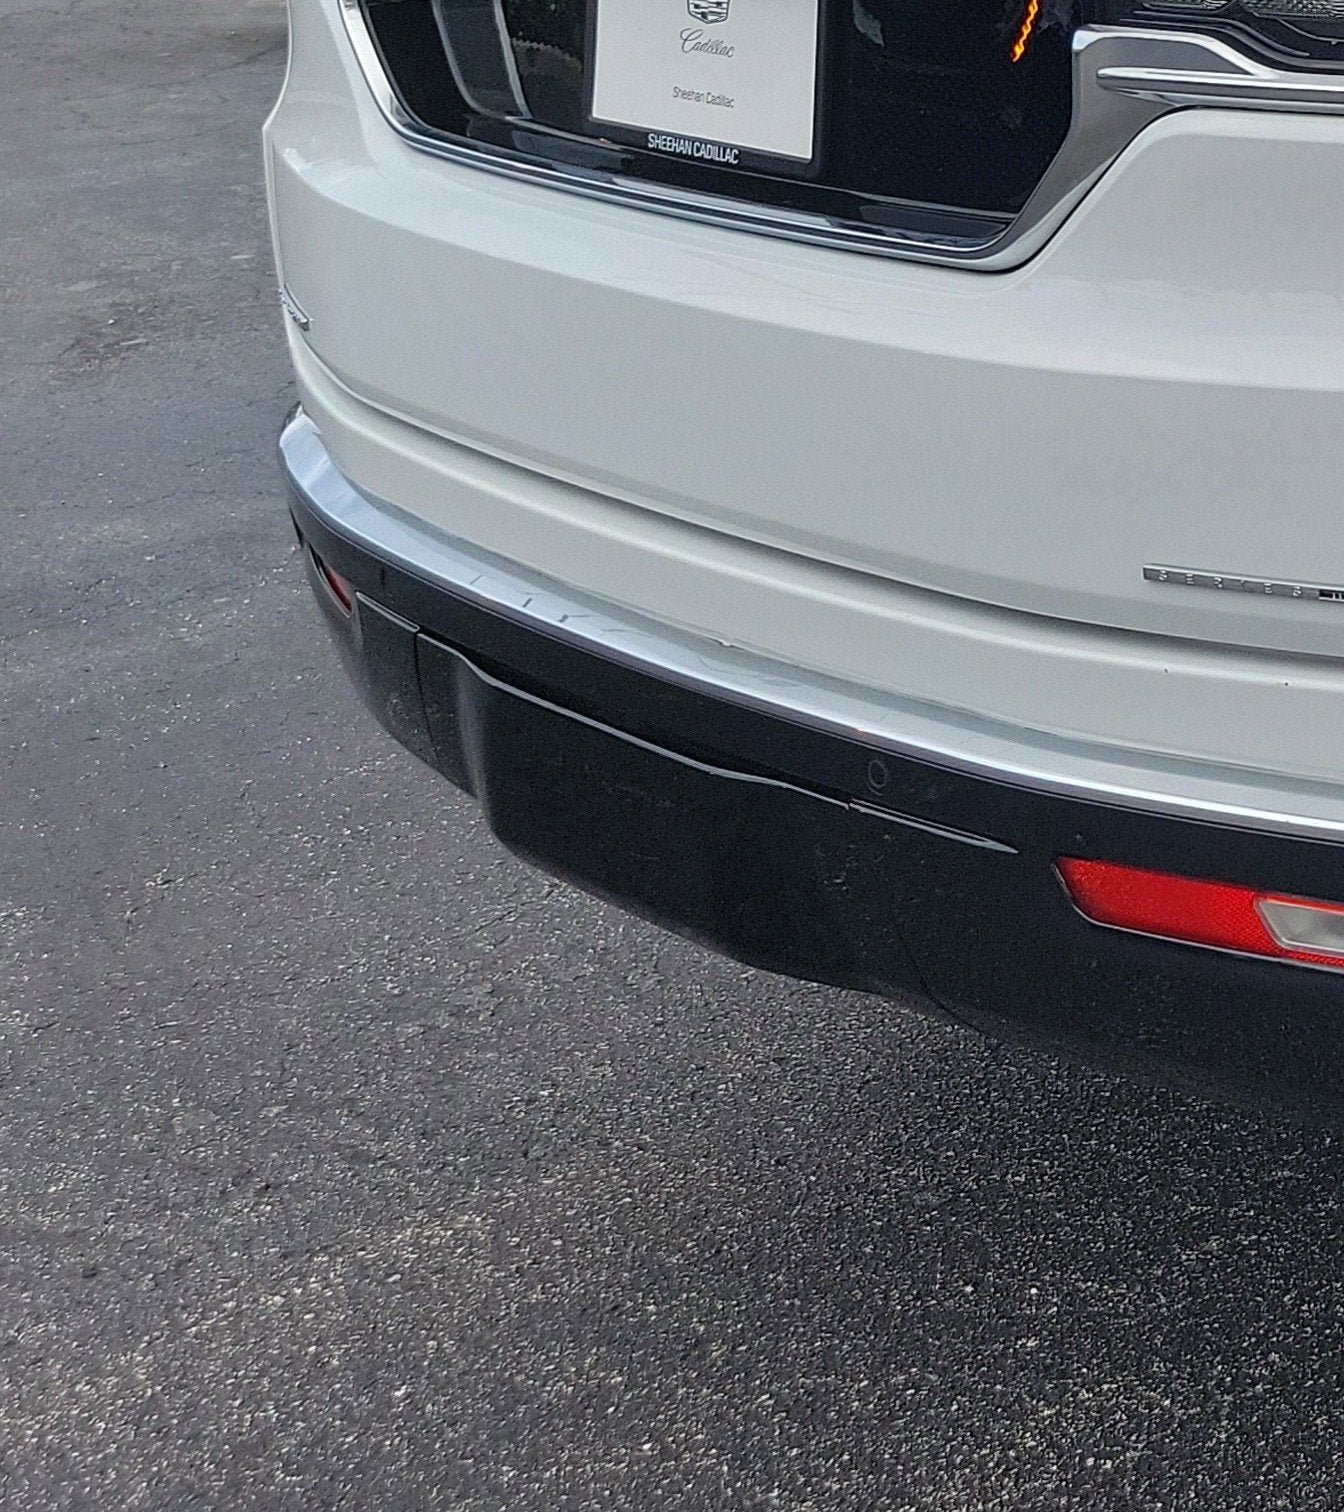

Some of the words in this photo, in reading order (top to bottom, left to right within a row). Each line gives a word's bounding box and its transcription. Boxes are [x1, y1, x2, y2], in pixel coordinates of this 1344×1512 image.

[679, 27, 735, 59] Cadillac
[648, 133, 693, 156] SHEEHAN
[693, 141, 739, 165] CADILLAC
